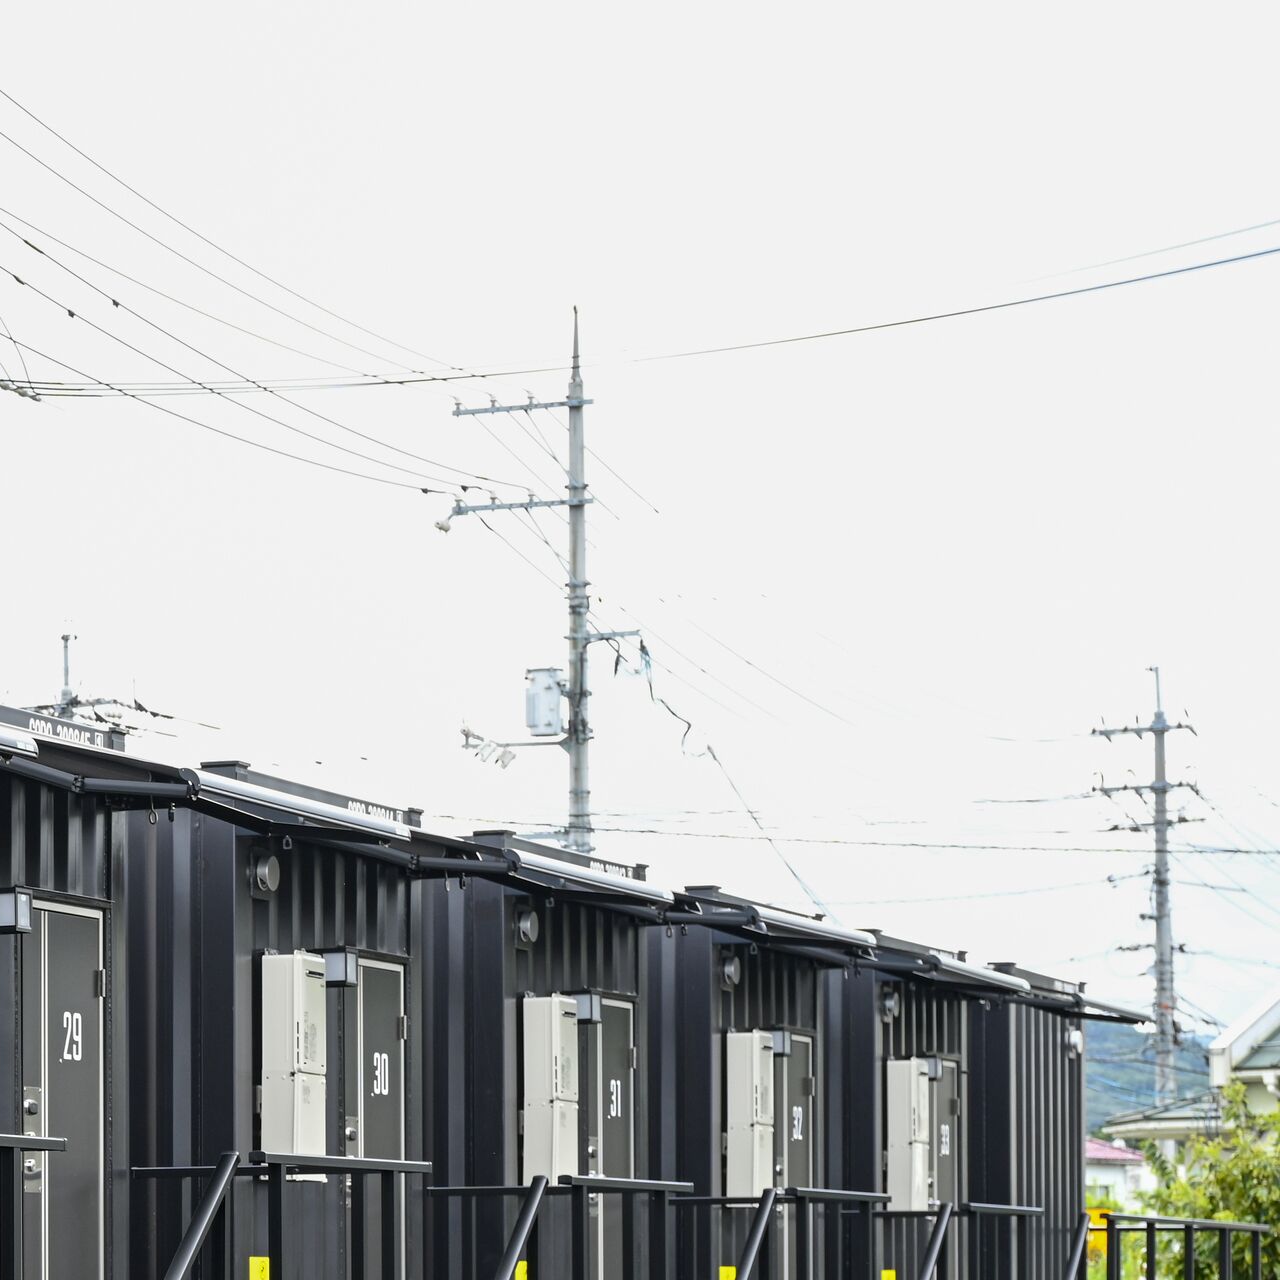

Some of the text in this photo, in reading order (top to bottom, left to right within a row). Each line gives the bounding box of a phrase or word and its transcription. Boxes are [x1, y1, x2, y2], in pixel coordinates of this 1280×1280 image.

[63, 1011, 82, 1061] 29
[373, 1052, 389, 1095] 30
[610, 1079, 621, 1117] 31
[792, 1105, 803, 1140] 32
